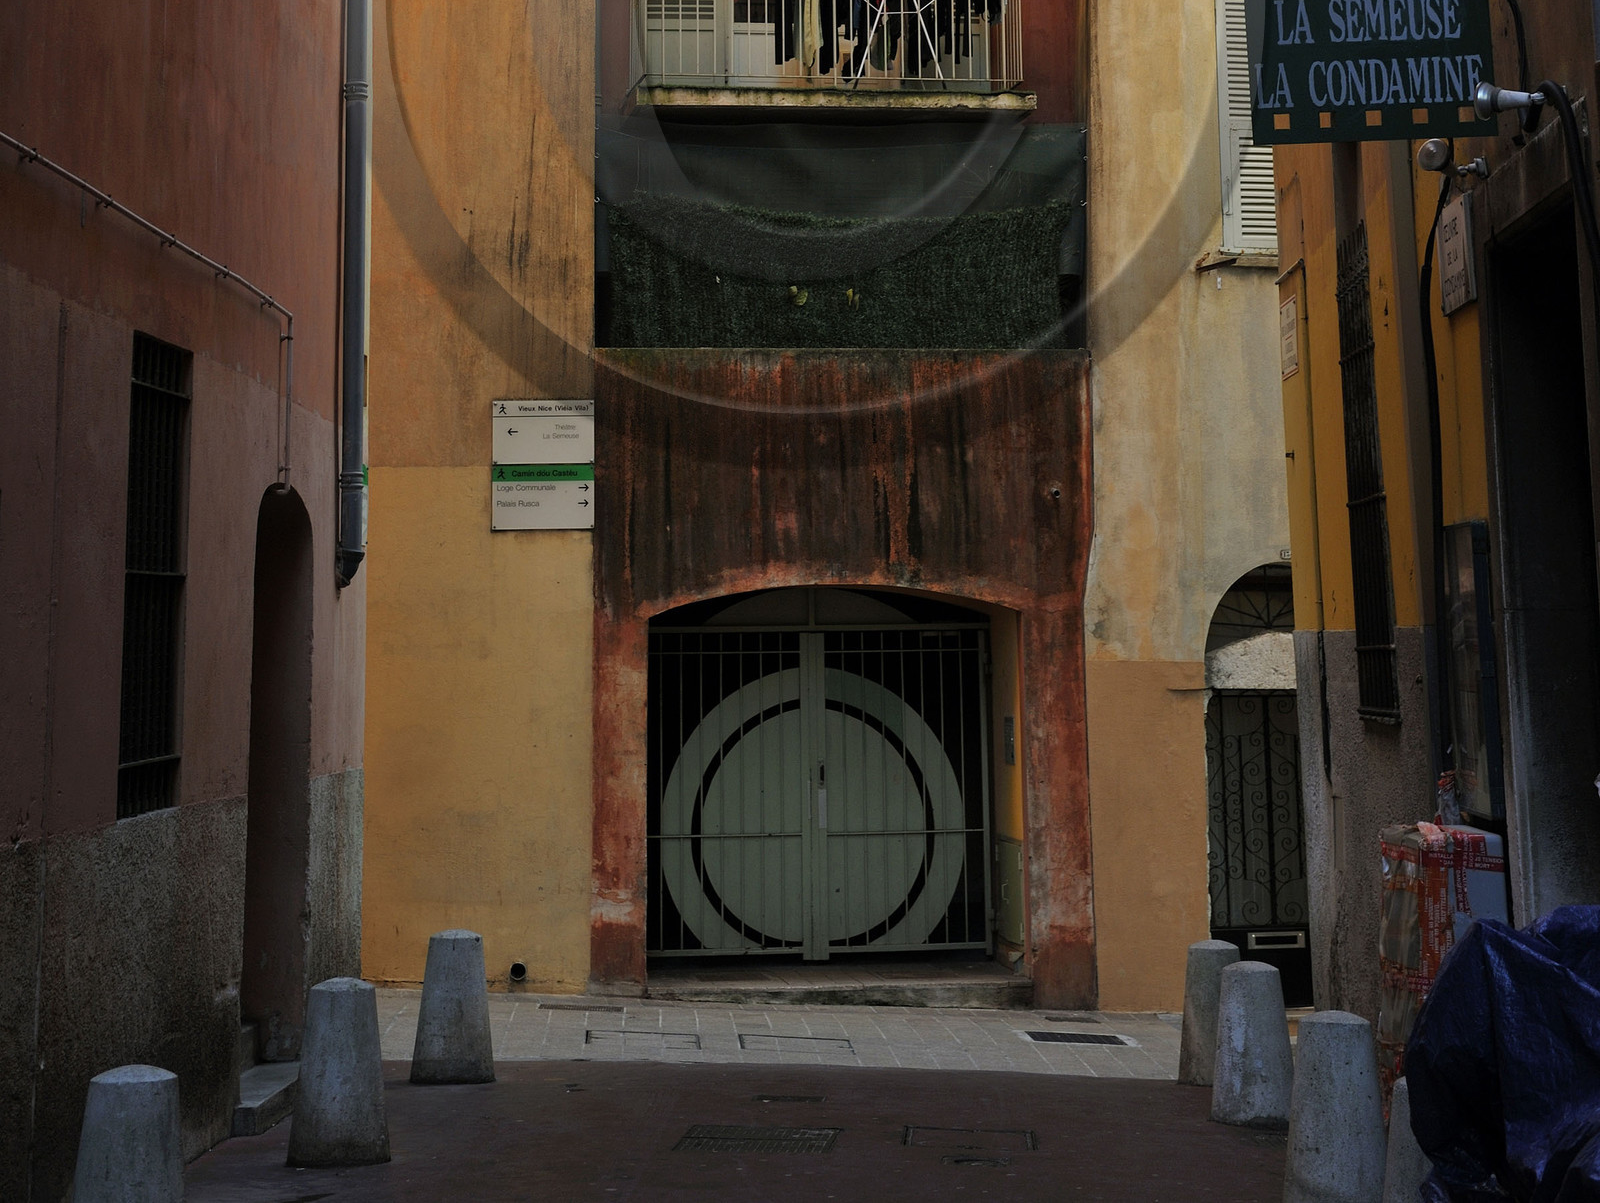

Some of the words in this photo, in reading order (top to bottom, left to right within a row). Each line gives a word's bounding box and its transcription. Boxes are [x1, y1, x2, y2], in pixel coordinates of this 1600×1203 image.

[1274, 0, 1315, 46] LA
[1255, 62, 1294, 109] LA
[1308, 54, 1484, 107] CONDAMINE
[511, 469, 534, 478] Camin
[496, 484, 514, 493] Loge
[518, 499, 540, 507] Rusca
